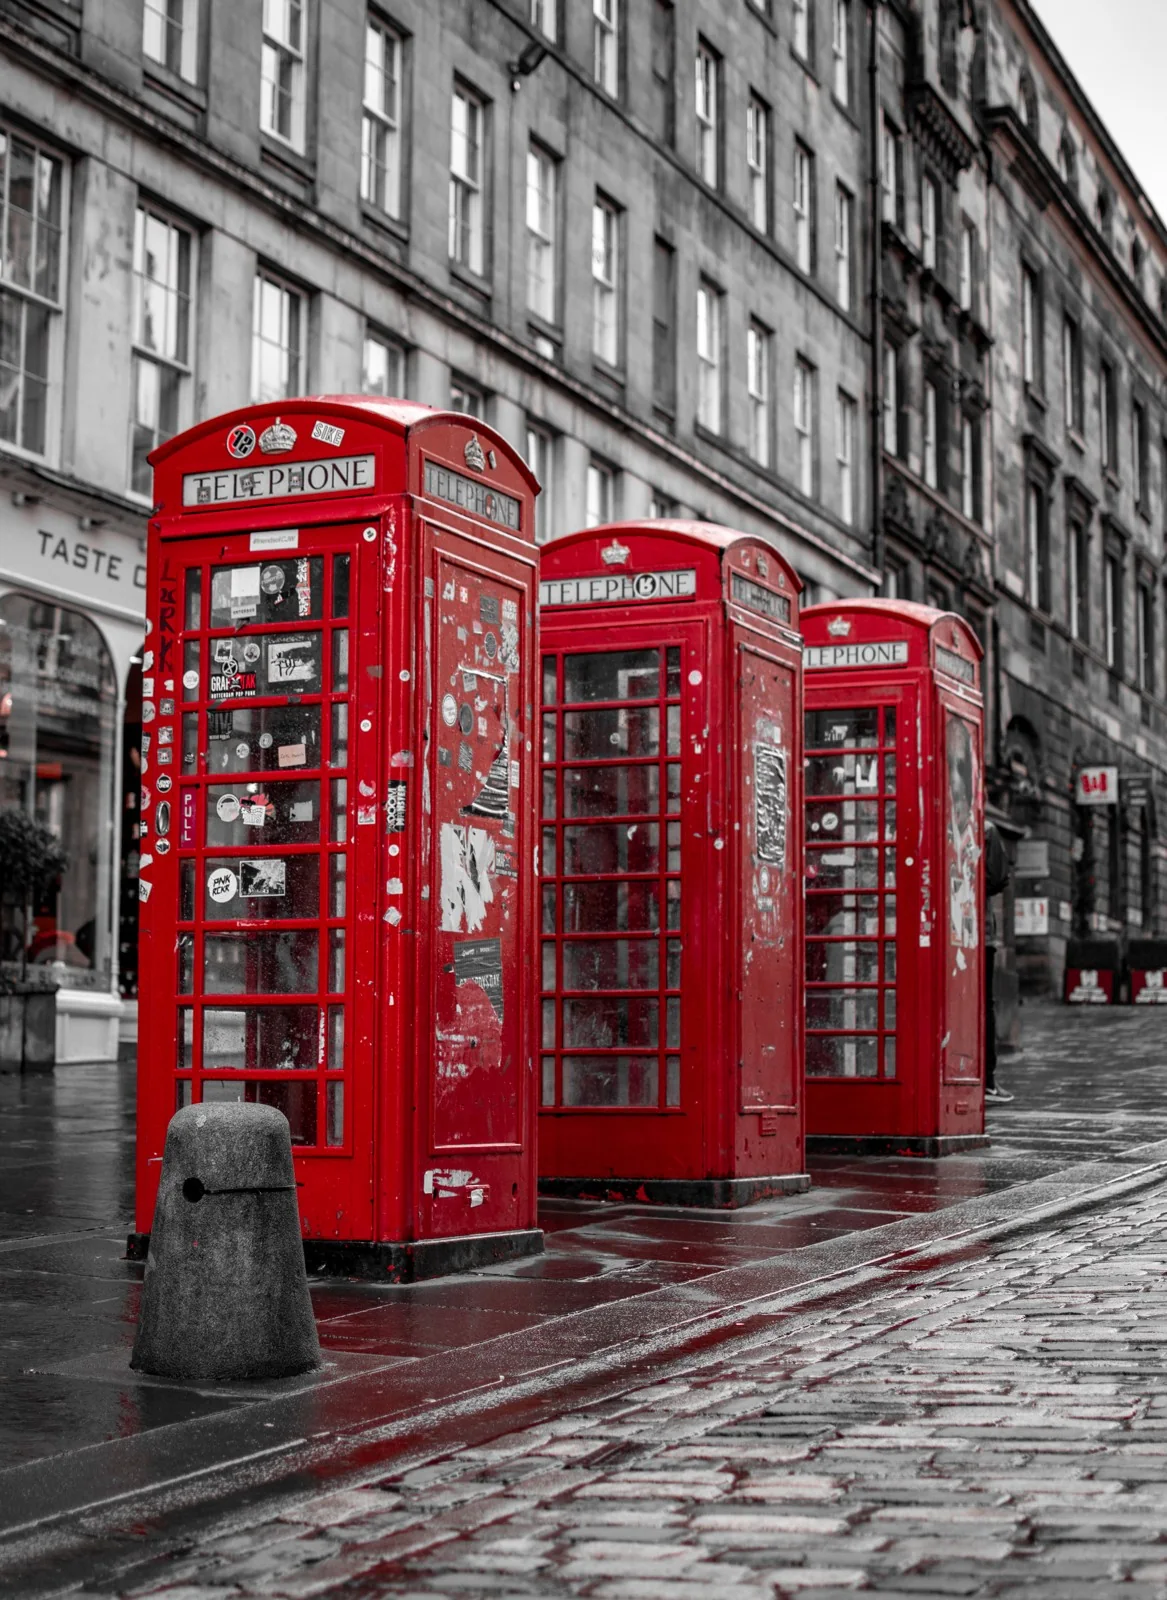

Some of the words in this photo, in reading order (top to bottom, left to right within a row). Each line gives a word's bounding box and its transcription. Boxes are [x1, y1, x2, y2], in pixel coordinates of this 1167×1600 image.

[314, 422, 344, 446] SIKE
[193, 459, 368, 502] TELEPHONE
[37, 529, 122, 581] TASTE
[542, 573, 689, 604] TELEPHNE
[807, 643, 903, 666] LEPHONE
[184, 793, 193, 841] PULL
